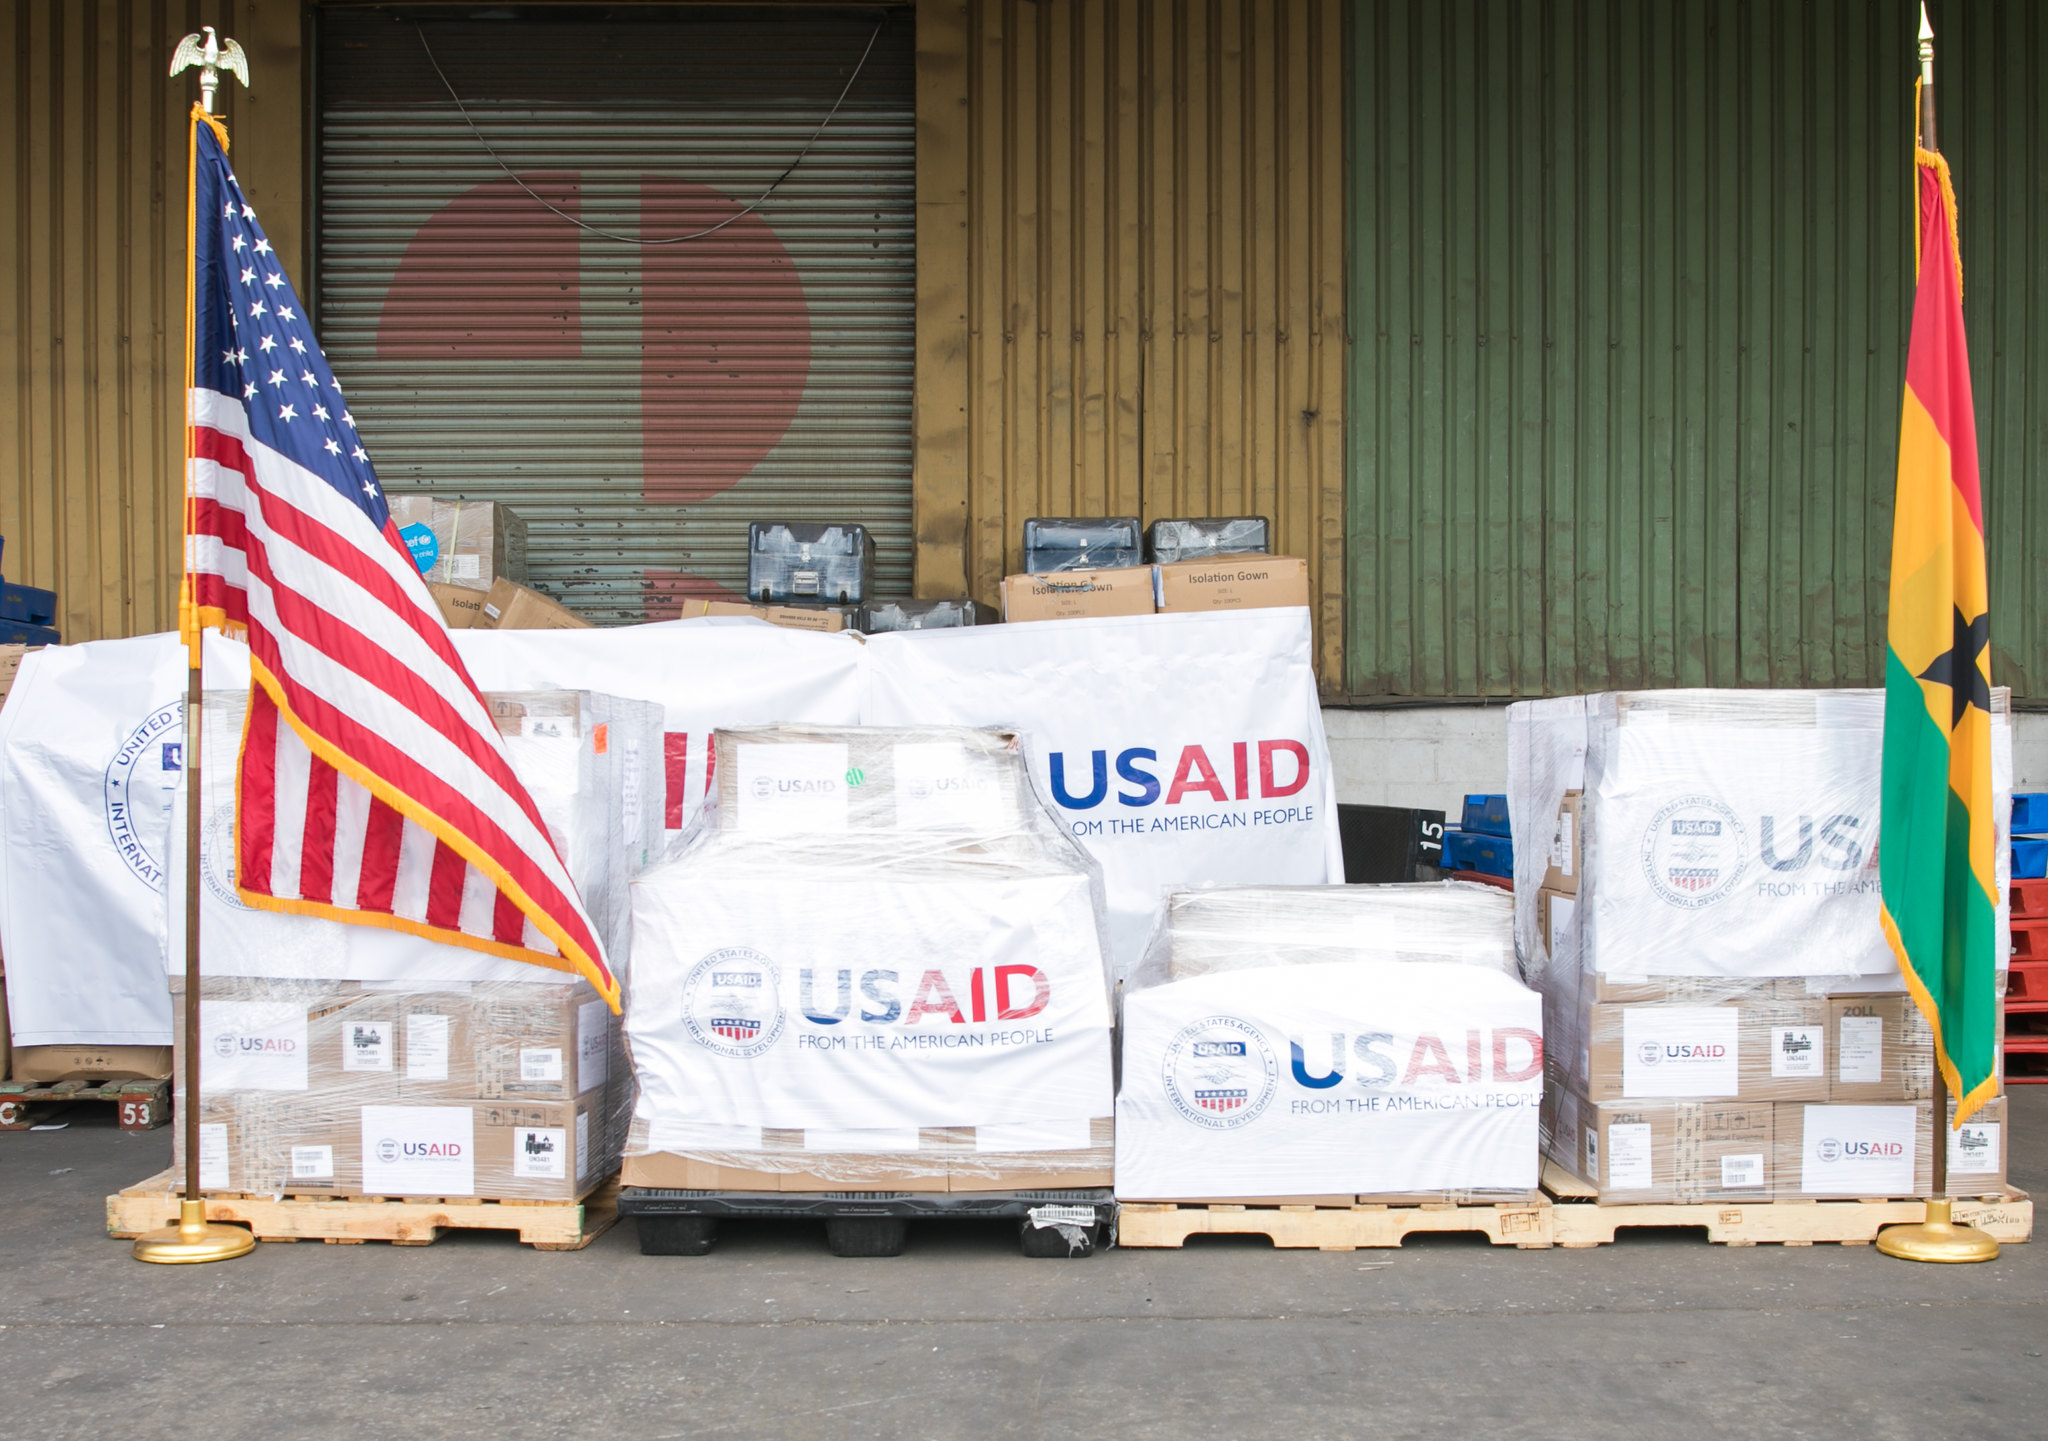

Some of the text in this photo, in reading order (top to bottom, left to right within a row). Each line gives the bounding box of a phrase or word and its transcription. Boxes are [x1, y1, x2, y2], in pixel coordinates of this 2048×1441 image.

[1189, 571, 1269, 584] Isolation Gown
[116, 712, 172, 766] UNITED
[1049, 739, 1310, 810] USAID
[778, 779, 836, 793] USAID
[1072, 806, 1314, 836] OM THE AMERICAN PEOPLE
[1650, 803, 1678, 832] UNITED
[1677, 822, 1716, 833] USAID
[111, 802, 163, 883] INTERNAT
[1420, 820, 1444, 850] 15
[1758, 882, 1806, 897] FROM
[1813, 881, 1844, 895] THE
[688, 955, 717, 985] UNITED
[716, 975, 758, 985] USAID
[800, 964, 1051, 1025] USAID
[1843, 1005, 1877, 1017] ZOLL
[240, 1038, 296, 1053] USAID
[799, 1028, 1054, 1050] FROM THE AMERICAN PEOPLE
[1199, 1018, 1236, 1029] STATES
[1236, 1023, 1271, 1054] AGENCY
[1197, 1042, 1242, 1055] USAID
[1290, 1027, 1544, 1090] USAID
[1666, 1045, 1725, 1058] USAID
[1165, 1071, 1276, 1128] INTERNATIONAL DEVELOPMENT
[1291, 1099, 1340, 1114] FROM
[1346, 1097, 1380, 1112] THE
[1386, 1094, 1479, 1111] AMERICAN
[123, 1103, 150, 1125] 53
[1612, 1113, 1647, 1125] ZOLL
[403, 1143, 461, 1157] USAID
[1845, 1142, 1903, 1155] USAID
